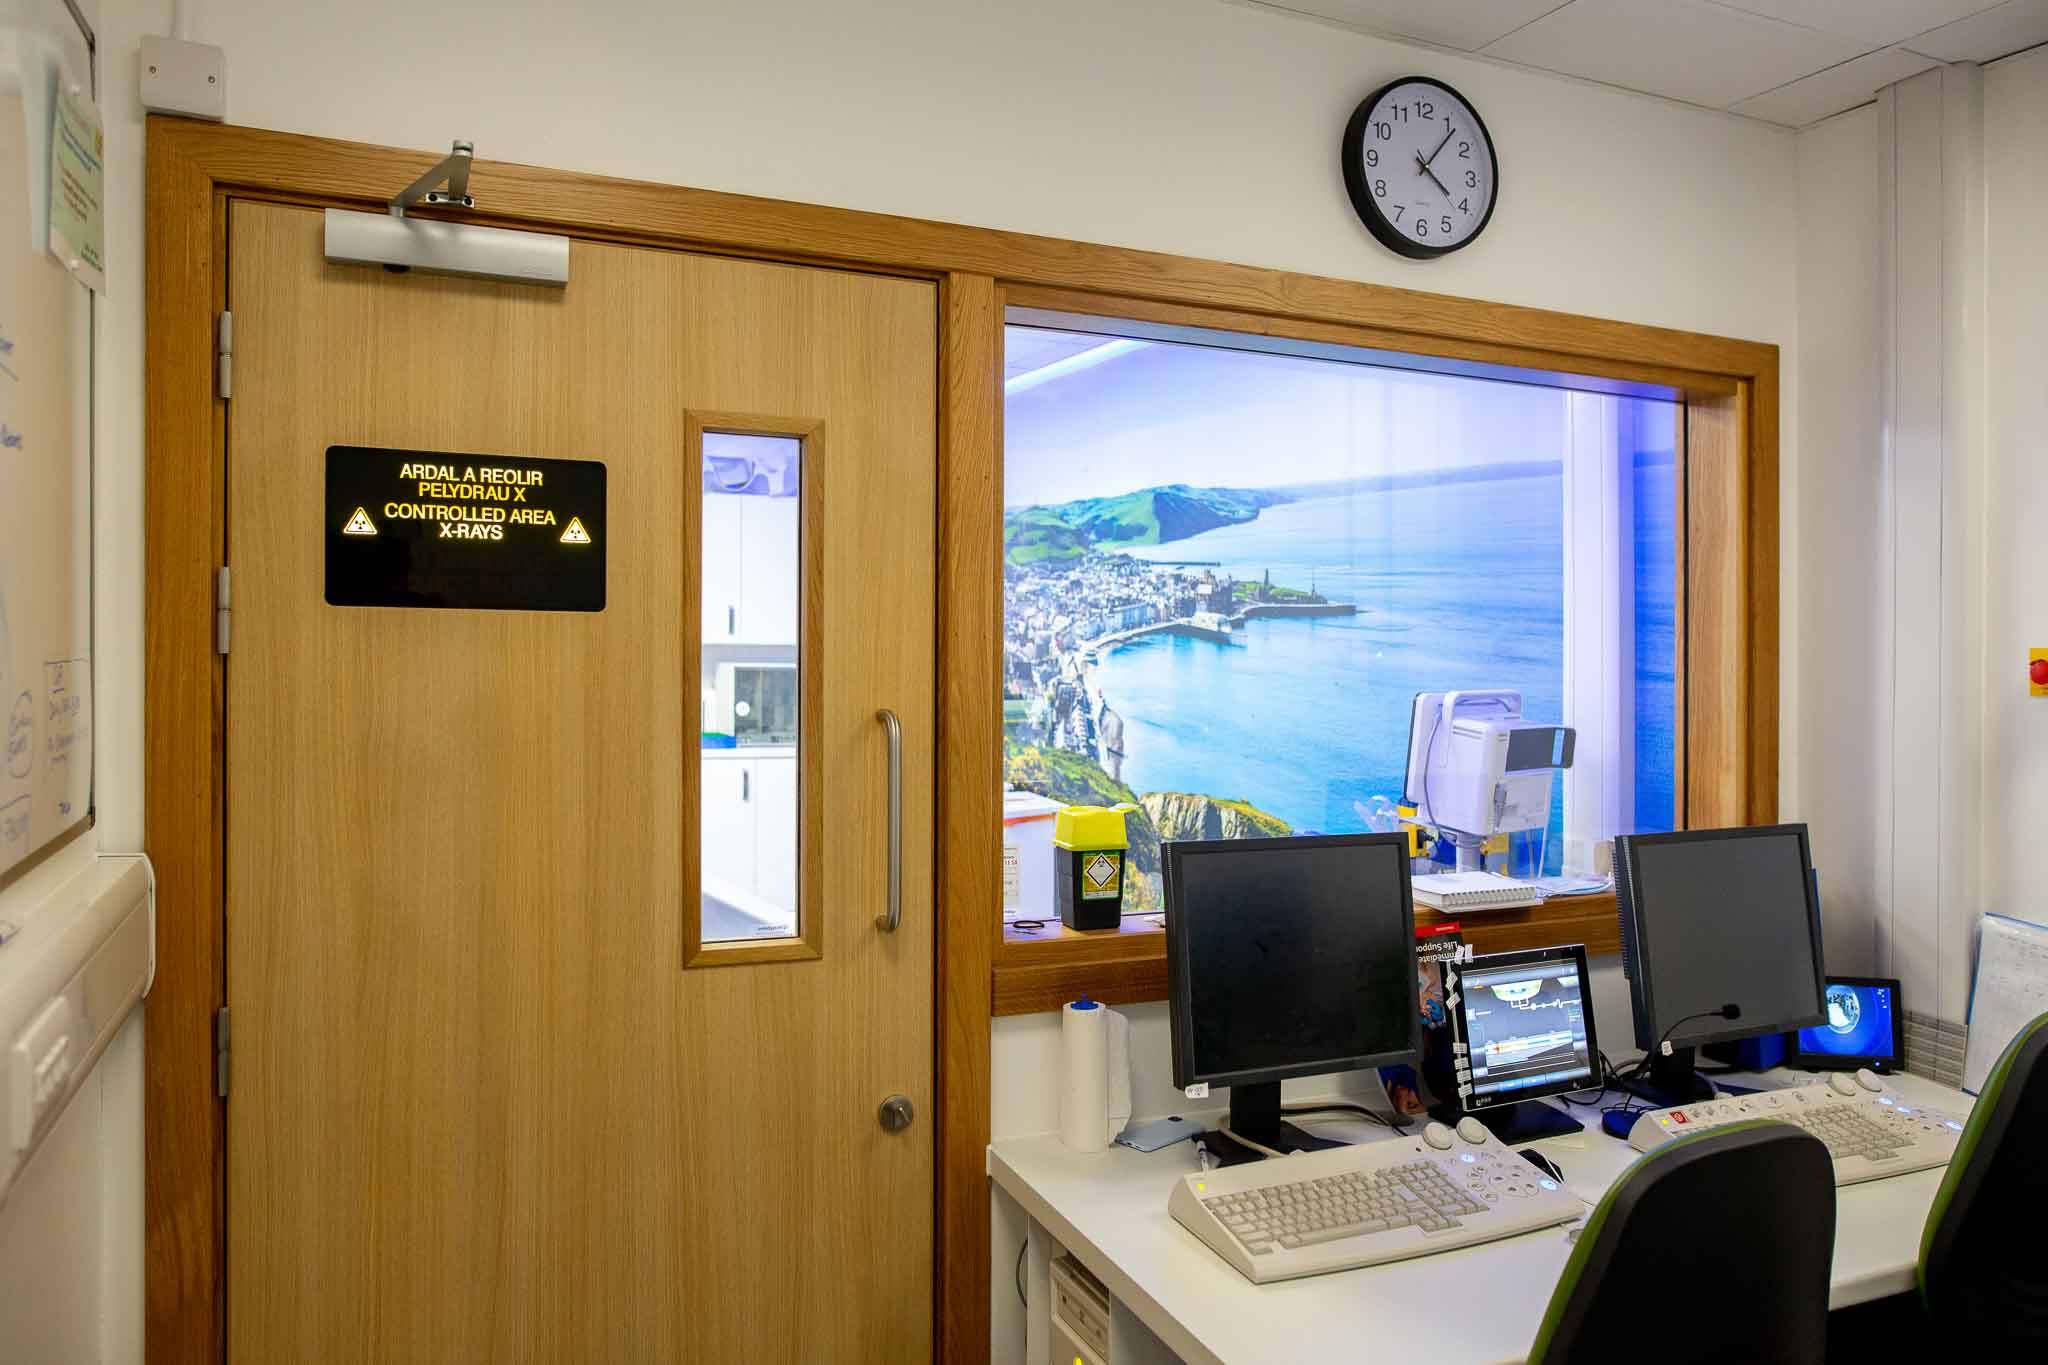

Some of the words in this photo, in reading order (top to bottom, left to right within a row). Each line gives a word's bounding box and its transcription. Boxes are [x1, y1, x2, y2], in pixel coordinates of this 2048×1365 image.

[1391, 103, 1408, 123] 11
[1413, 101, 1434, 120] 12
[1373, 121, 1392, 141] 10
[1443, 117, 1451, 132] 1
[1366, 149, 1379, 167] 9
[1458, 141, 1470, 159] 2
[1374, 179, 1387, 197] 8
[1465, 170, 1477, 188] 3
[1393, 204, 1405, 222] 7
[1458, 197, 1469, 215] 4
[1416, 218, 1428, 236] 6
[1440, 215, 1452, 233] 5
[400, 463, 460, 482] ARDAL
[463, 466, 476, 483] A
[480, 468, 544, 486] REOLIR
[418, 482, 510, 502] PELYDRAU
[514, 487, 526, 502] X
[384, 502, 506, 523] CONTROLLED
[509, 509, 556, 525] AREA
[440, 522, 504, 540] X-RAYS
